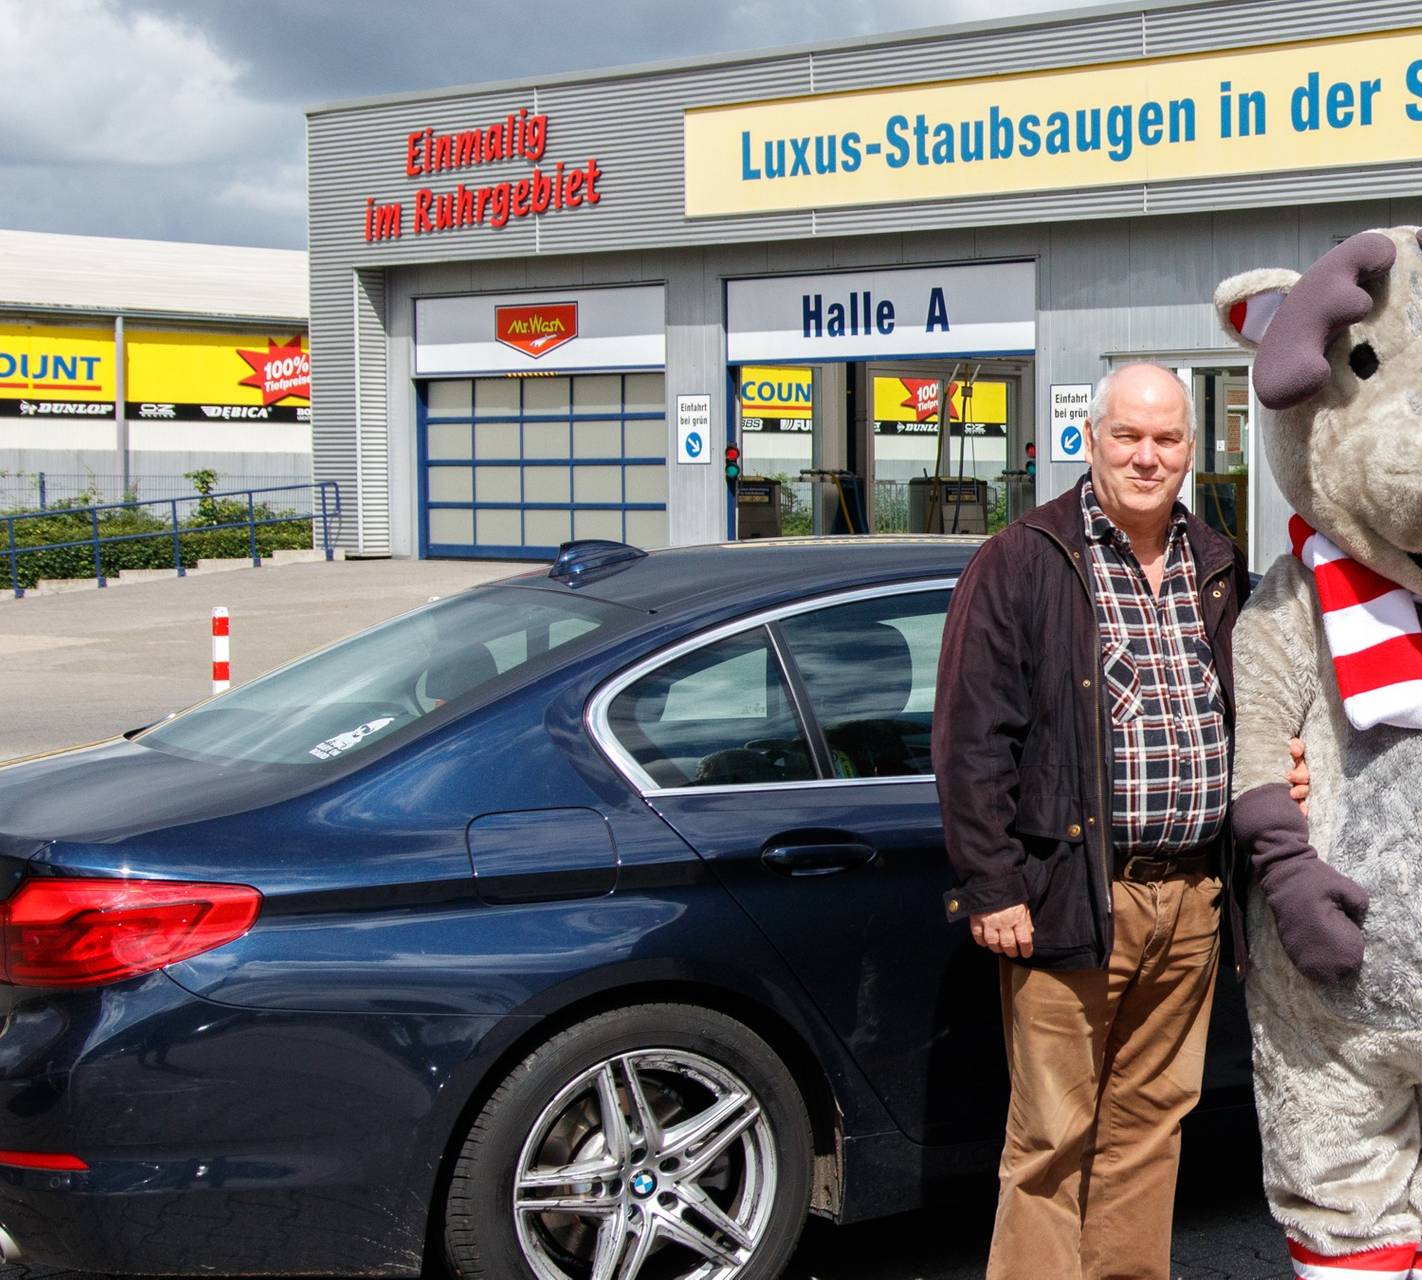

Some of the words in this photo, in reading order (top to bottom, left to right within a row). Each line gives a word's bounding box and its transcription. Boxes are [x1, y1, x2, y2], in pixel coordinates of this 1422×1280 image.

[741, 97, 1196, 181] Luxus-Staubsaugen
[1220, 81, 1266, 138] in
[1290, 72, 1381, 131] der
[405, 107, 548, 176] Einmalig
[365, 197, 402, 242] im
[413, 158, 602, 233] Ruhrgebiet
[802, 291, 895, 338] Halle
[926, 287, 950, 332] A
[264, 354, 309, 380] 100%
[917, 383, 938, 401] 100
[1055, 393, 1088, 404] Einfahrt
[37, 402, 114, 414] DUNLOP
[680, 402, 707, 412] Einfahrt
[1054, 408, 1067, 418] bei
[1069, 408, 1088, 420] grün
[680, 416, 690, 424] bei
[692, 415, 708, 427] grün
